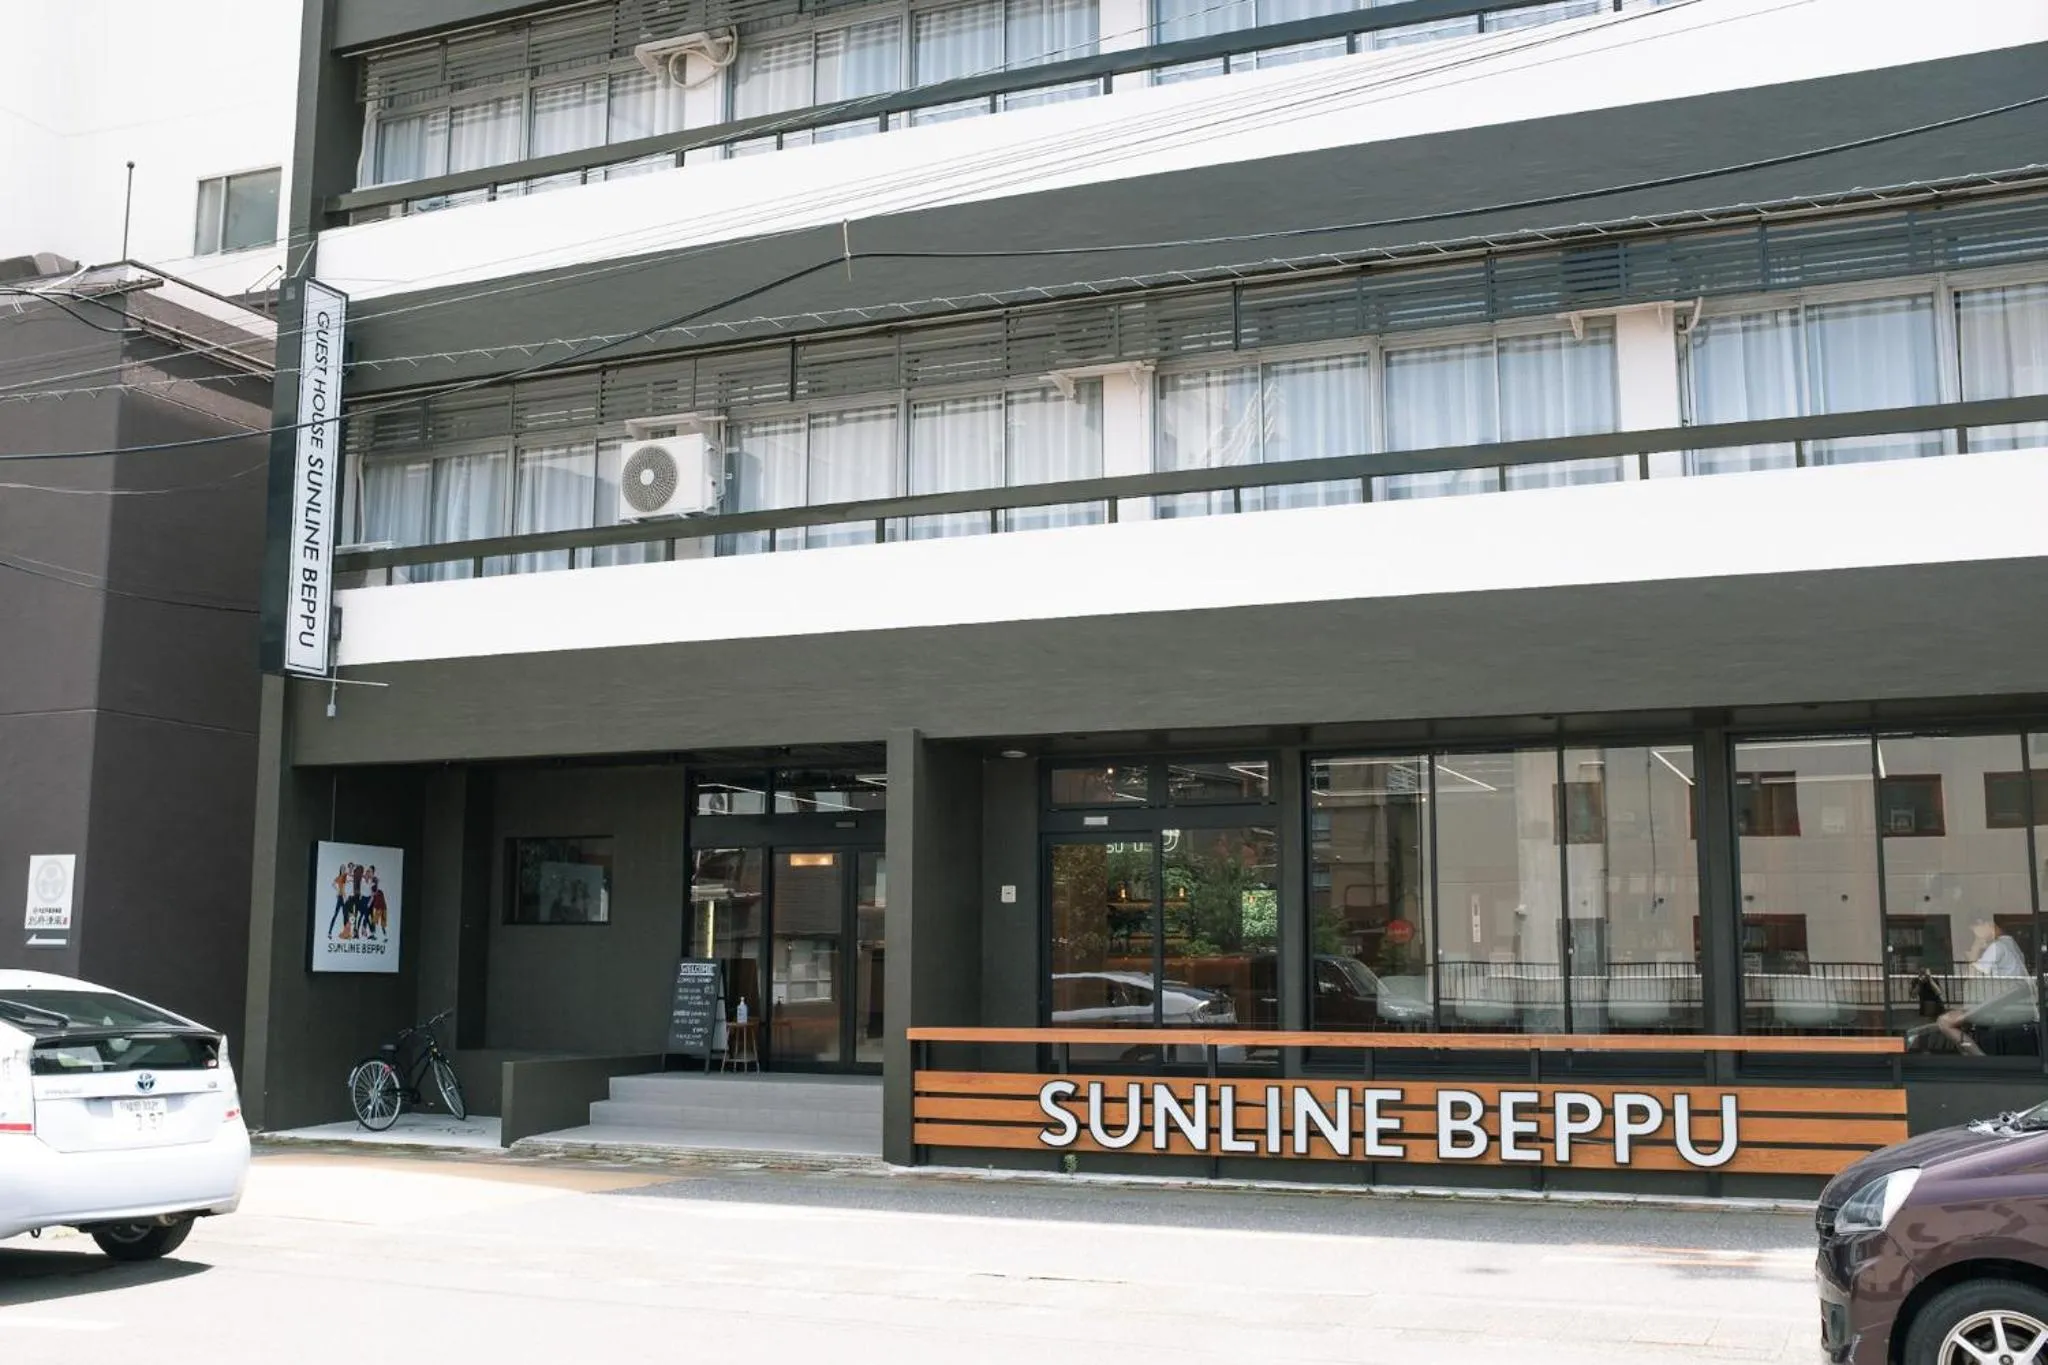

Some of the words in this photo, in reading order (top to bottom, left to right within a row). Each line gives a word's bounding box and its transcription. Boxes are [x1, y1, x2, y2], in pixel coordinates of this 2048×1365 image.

[315, 311, 330, 376] GUEST
[310, 378, 326, 449] HOUSE
[303, 454, 324, 561] SUNLINE
[299, 568, 318, 648] BEPPU
[1038, 1080, 1404, 1158] SUNLINE
[1436, 1088, 1738, 1168] BEPPU
